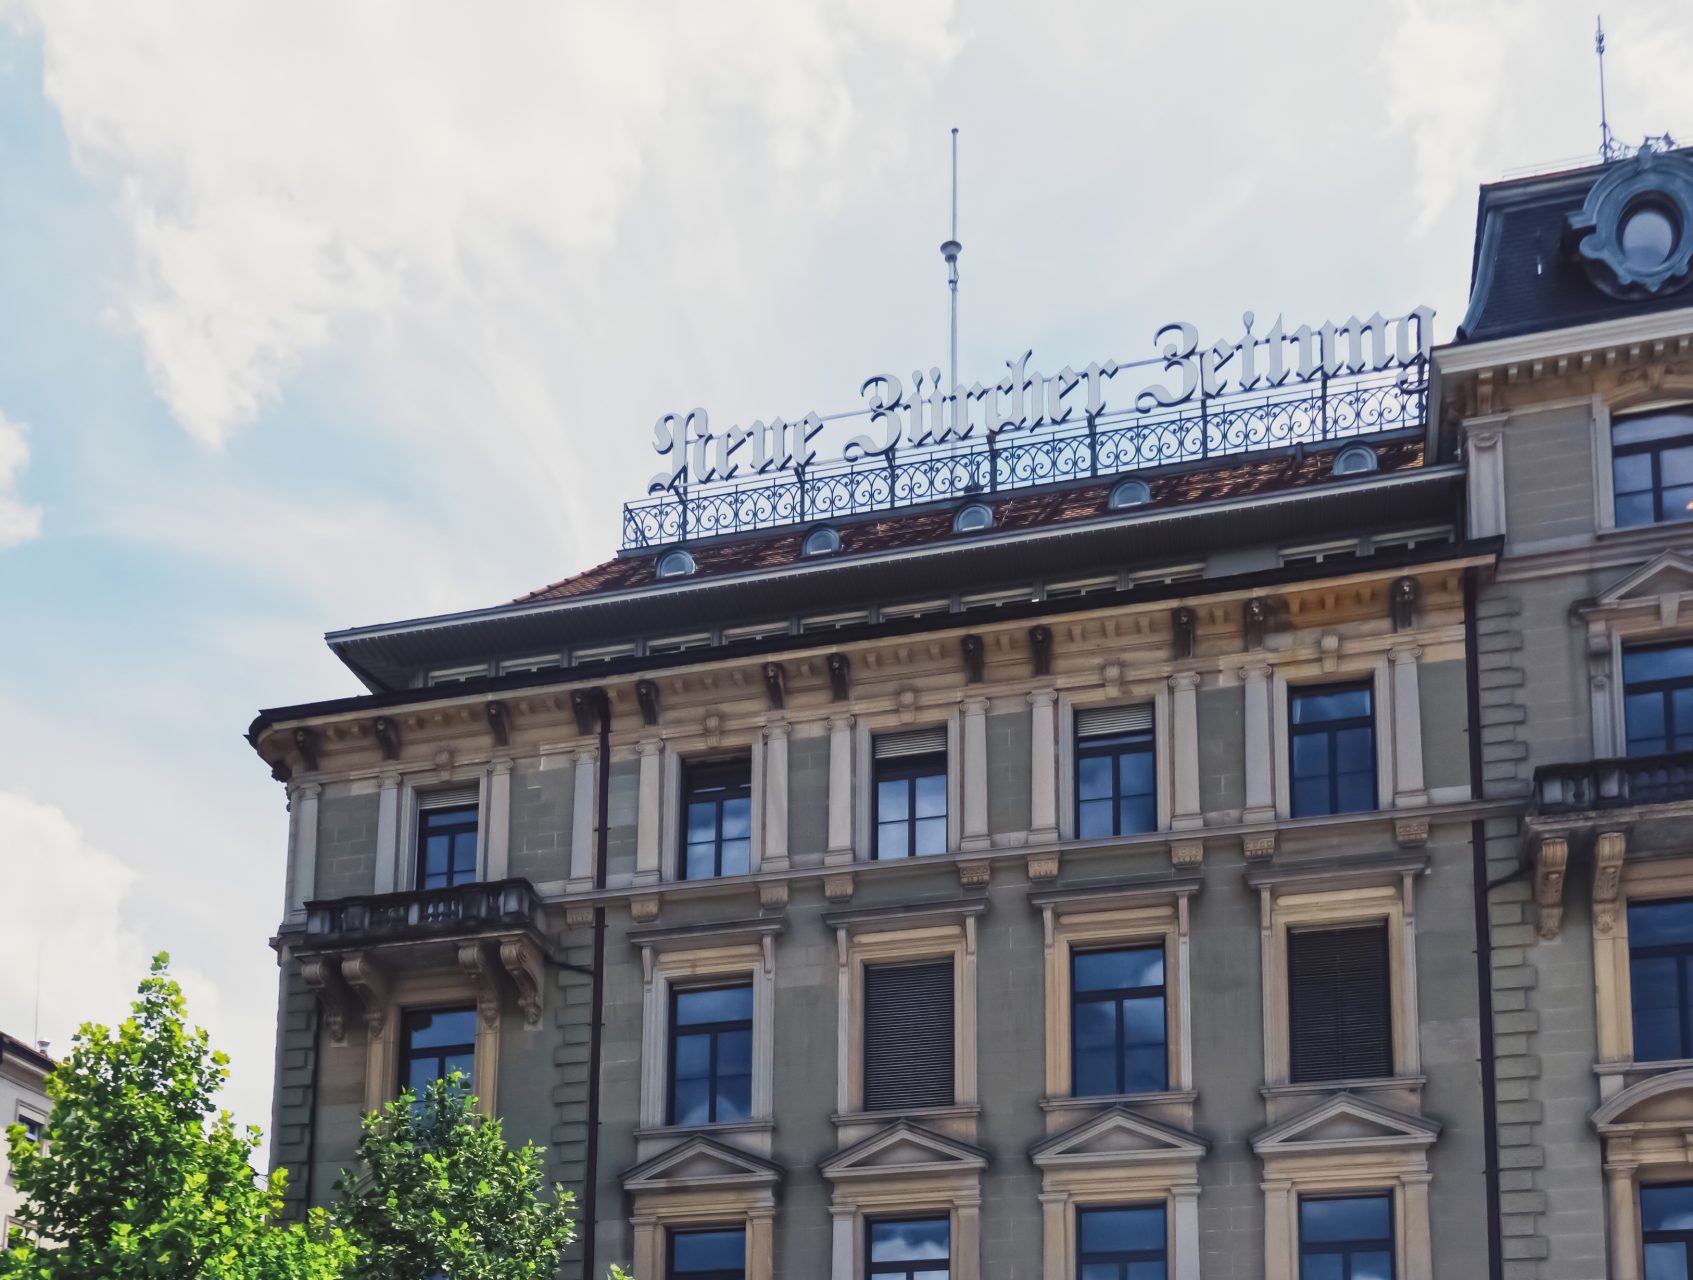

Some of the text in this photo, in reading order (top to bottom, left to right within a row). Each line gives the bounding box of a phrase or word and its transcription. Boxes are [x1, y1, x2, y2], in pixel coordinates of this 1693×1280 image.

[647, 304, 1437, 496] Neue Zürcher Zeitung
